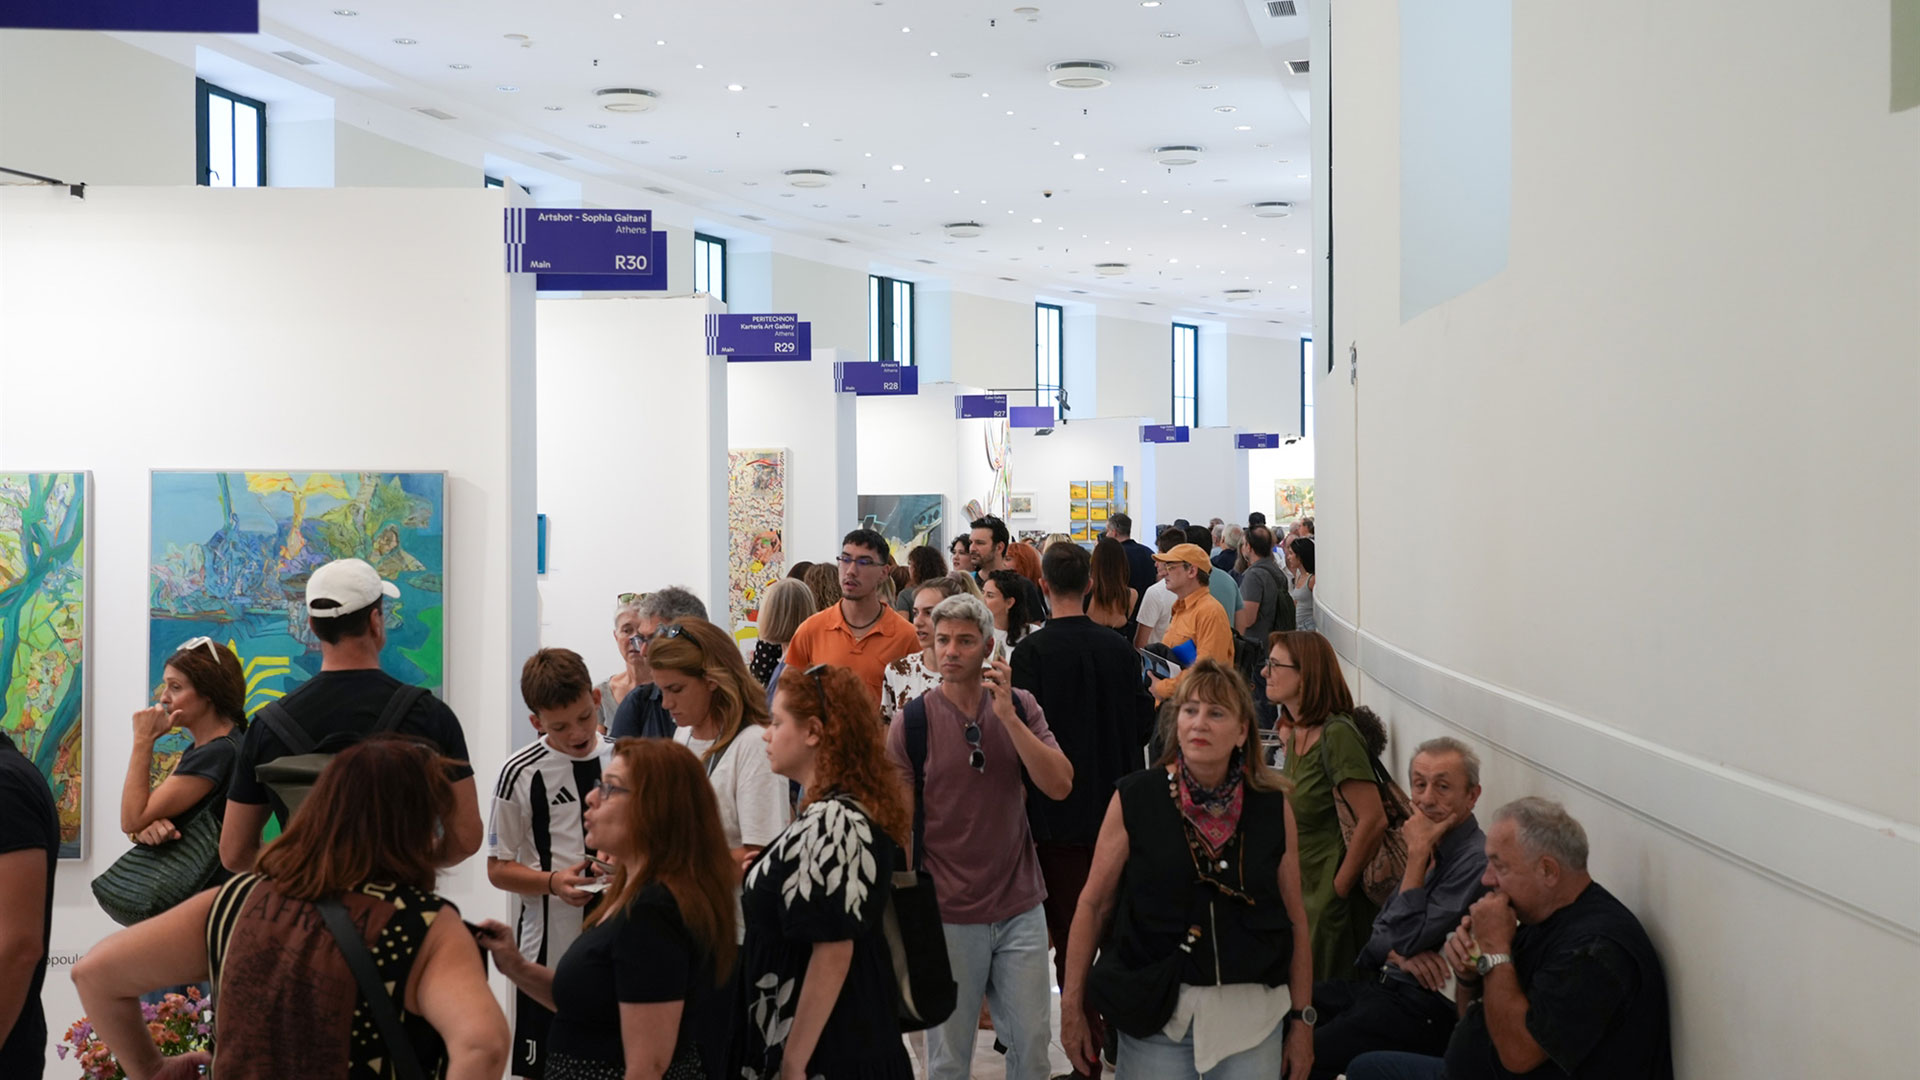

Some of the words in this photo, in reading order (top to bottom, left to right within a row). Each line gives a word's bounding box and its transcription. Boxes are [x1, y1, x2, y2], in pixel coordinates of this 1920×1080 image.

[537, 213, 573, 222] Artshot
[582, 213, 613, 224] Sophia
[614, 213, 647, 223] Gaitani
[616, 225, 647, 234] Athens
[530, 260, 551, 269] Main
[615, 255, 647, 270] R30
[774, 323, 795, 331] Gallery
[774, 342, 795, 353] R29
[883, 382, 899, 390] R28
